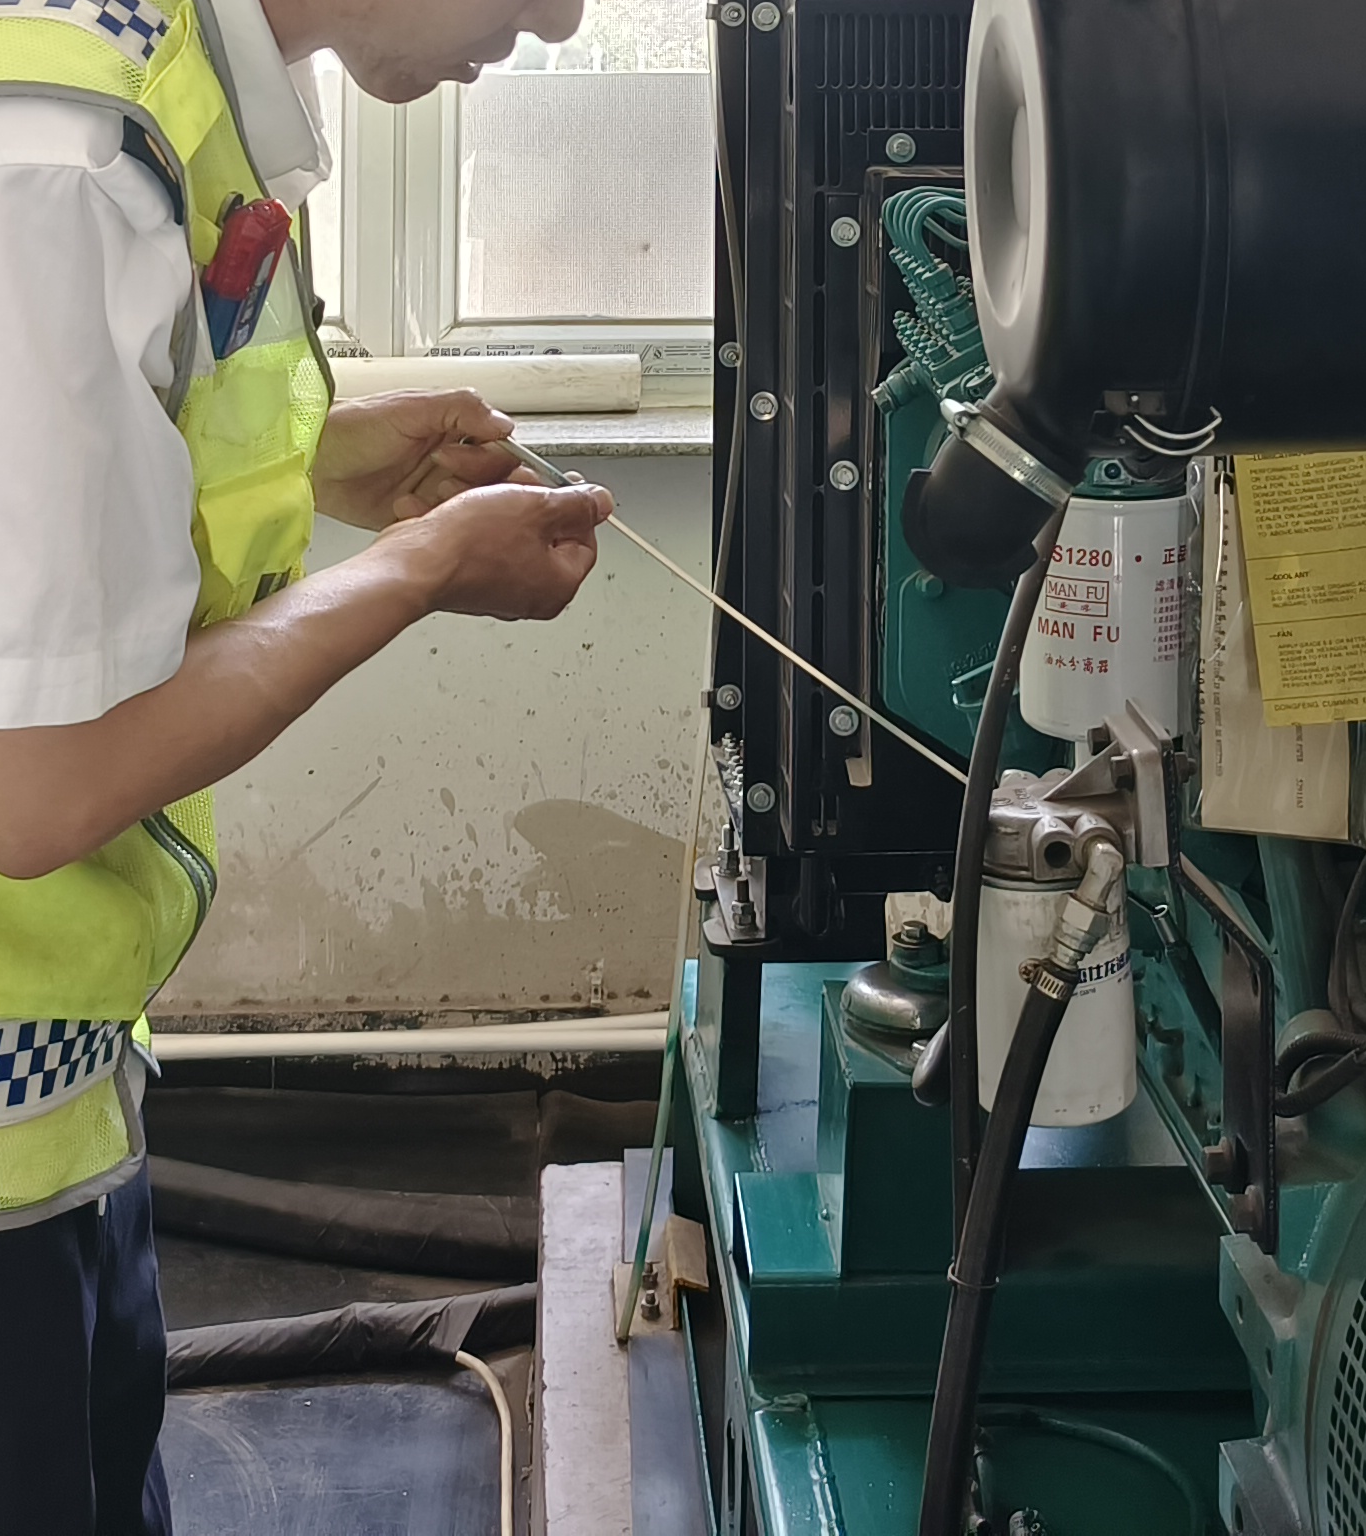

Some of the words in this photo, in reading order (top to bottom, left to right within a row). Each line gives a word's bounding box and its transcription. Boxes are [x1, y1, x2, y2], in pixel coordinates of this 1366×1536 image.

[1051, 545, 1113, 567] S1280
[1162, 545, 1187, 564] 正品
[1048, 580, 1078, 597] MAN
[1086, 586, 1106, 601] FU
[1037, 616, 1076, 640] MAN
[1093, 625, 1121, 643] FU
